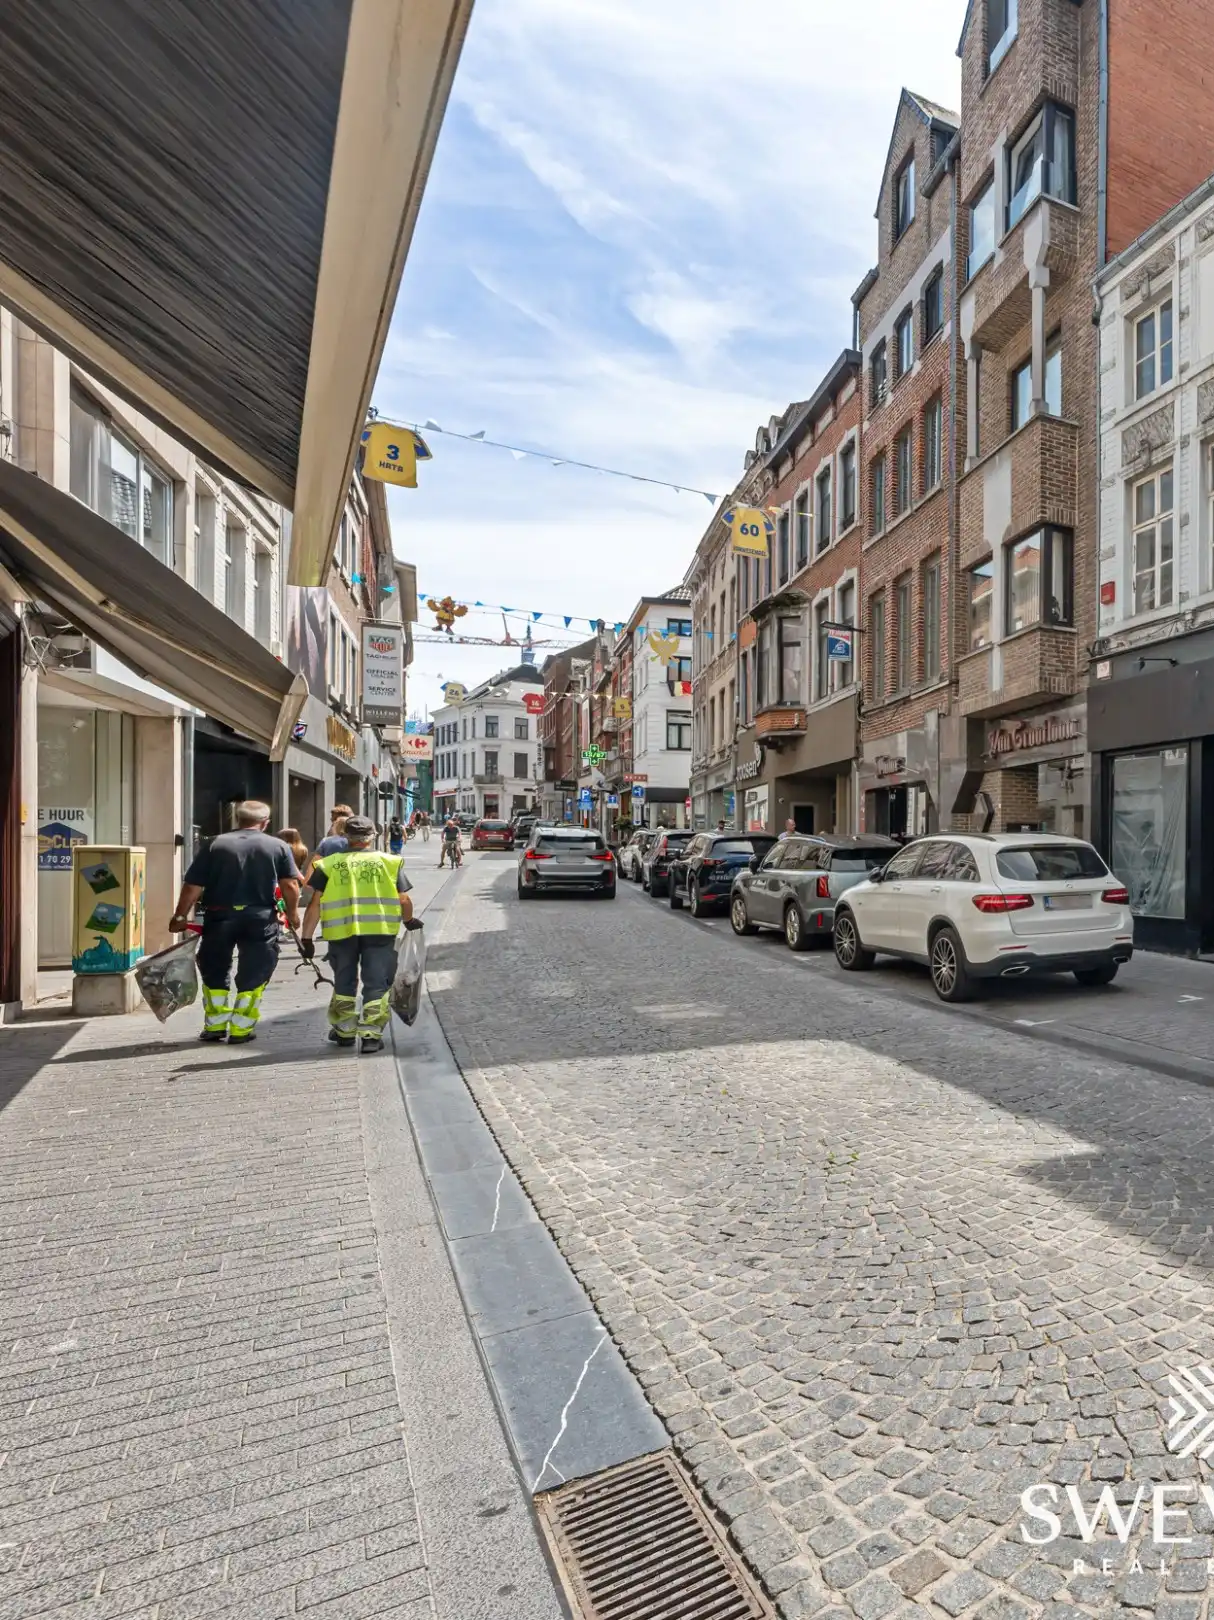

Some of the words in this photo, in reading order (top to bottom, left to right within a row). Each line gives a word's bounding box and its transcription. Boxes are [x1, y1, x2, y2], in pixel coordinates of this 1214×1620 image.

[386, 444, 400, 460] 3
[740, 523, 759, 536] 60
[368, 685, 397, 693] SERVICE
[582, 790, 590, 799] P
[49, 809, 84, 820] HUUR
